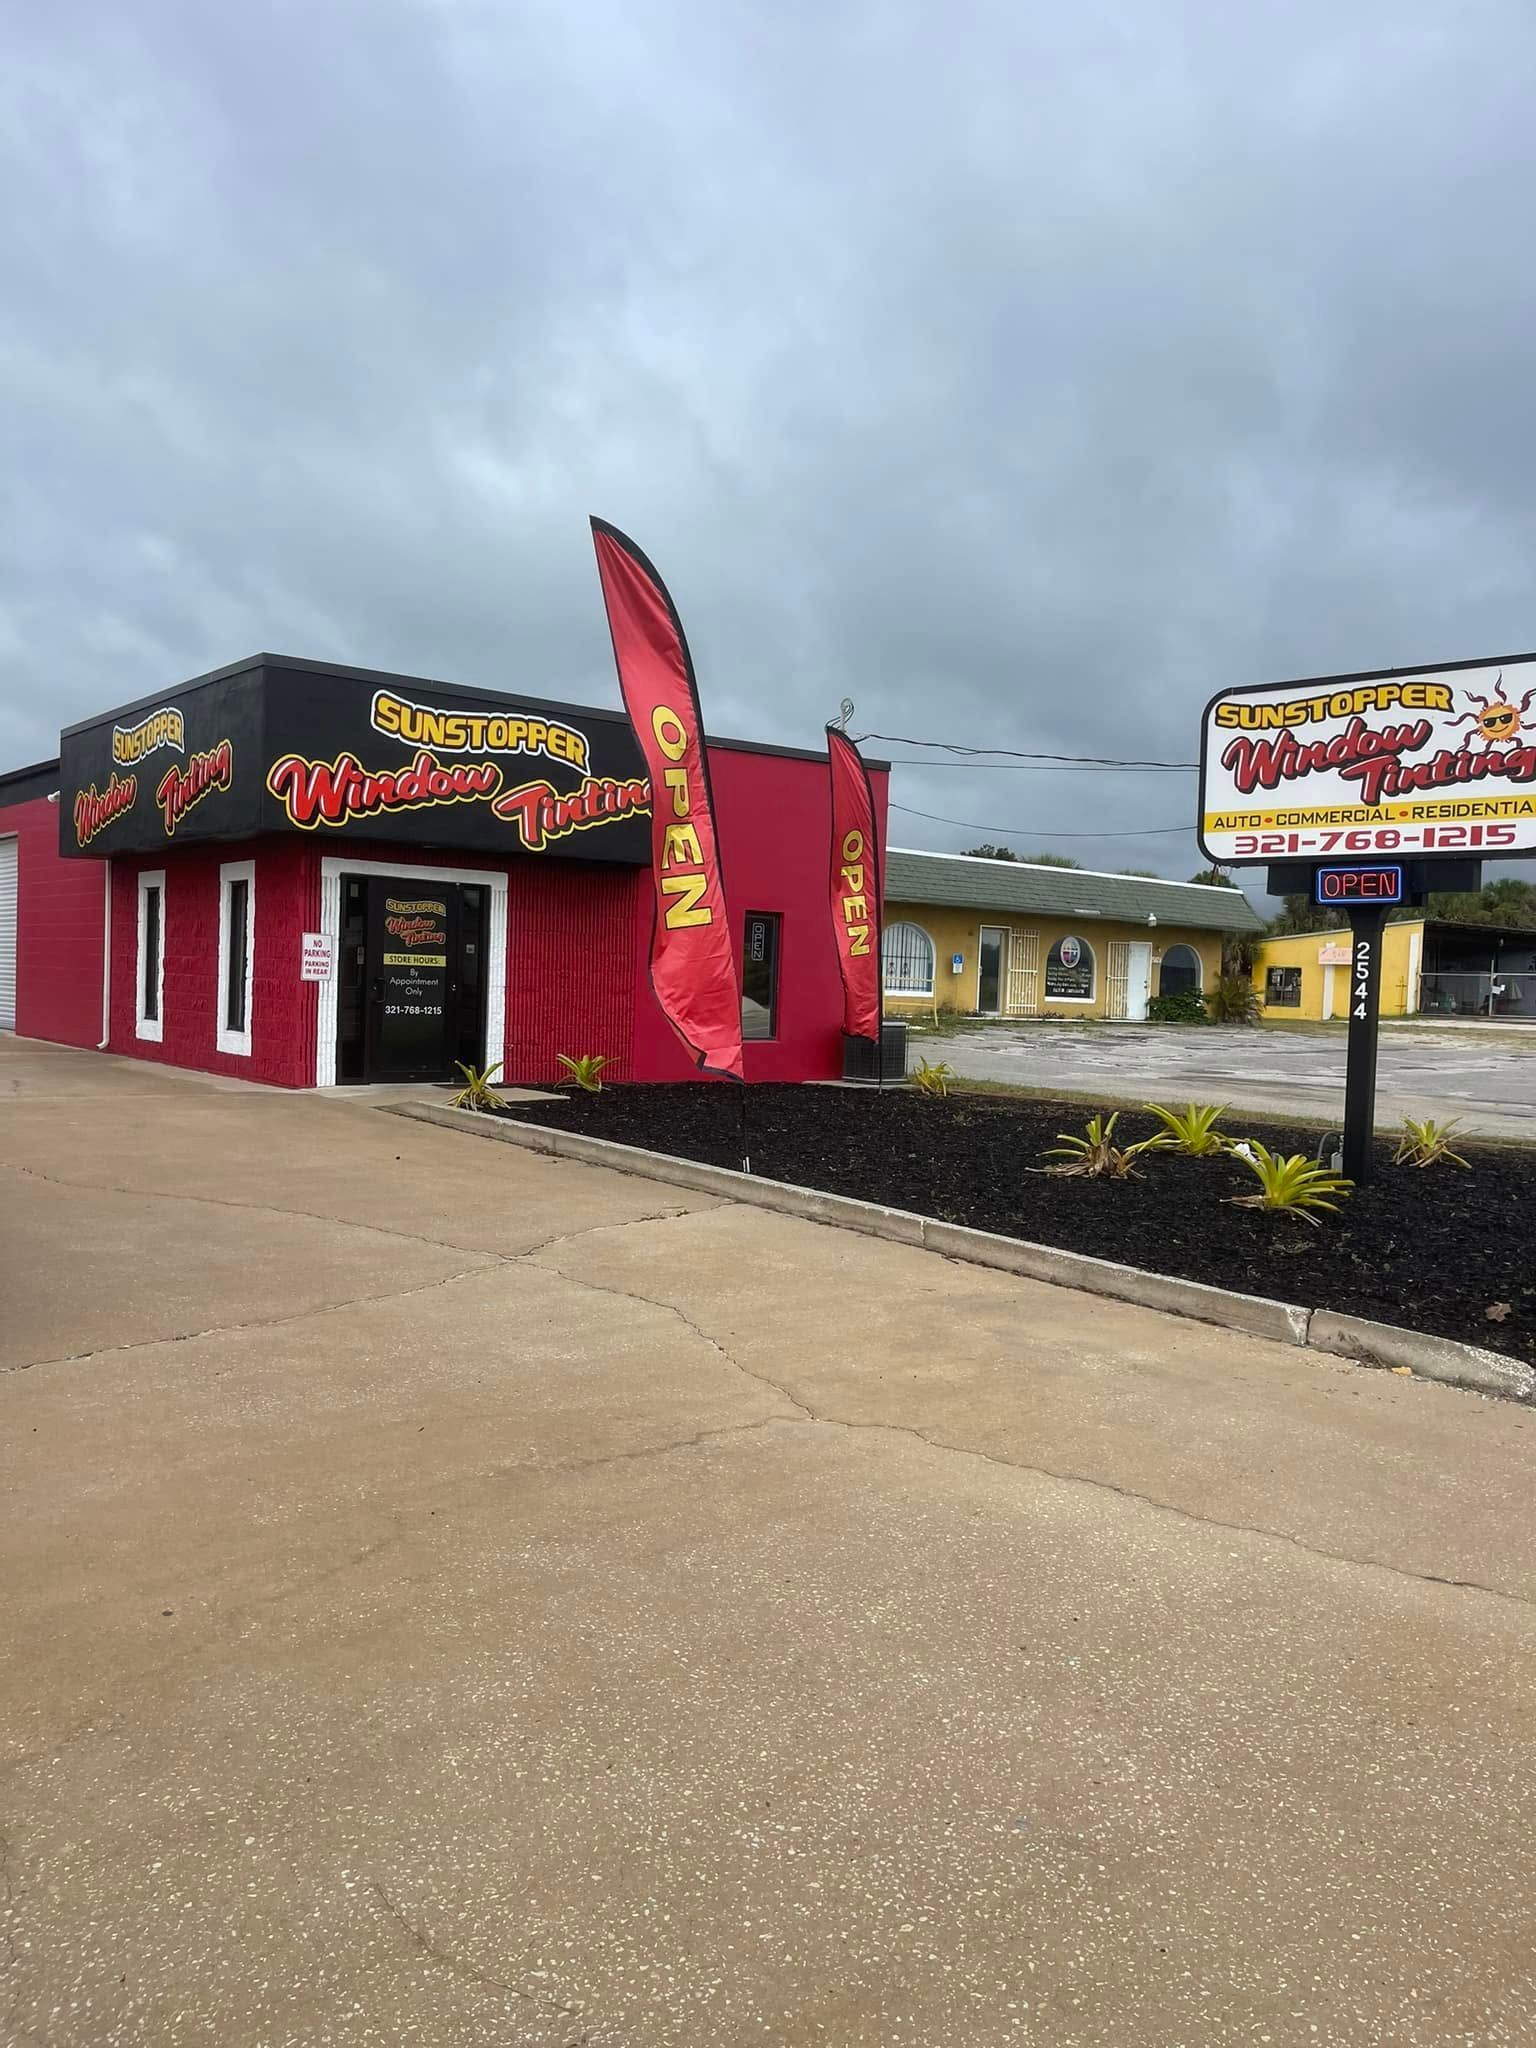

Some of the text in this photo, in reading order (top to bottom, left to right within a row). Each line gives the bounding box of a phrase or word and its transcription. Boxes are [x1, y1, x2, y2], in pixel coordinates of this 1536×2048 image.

[1215, 683, 1454, 729] SUNSTOPPER
[113, 708, 184, 765] SUNSTOPPER
[371, 690, 590, 775] SUNSTOPPER
[1221, 717, 1433, 793] Window
[1341, 747, 1536, 806] Tinting
[74, 739, 233, 847] Window Tinting
[268, 752, 652, 851] Window Tintin
[652, 704, 713, 931] OPEN
[1214, 800, 1536, 829] AUTO COMMERCIAL RESIDENTIA
[1234, 824, 1517, 855] 321-768-1215
[840, 829, 871, 957] OPEN
[1322, 872, 1397, 897] OPEN
[386, 898, 447, 917] SUNSTOPPER
[385, 917, 436, 935] Window
[400, 930, 446, 947] Tinting
[304, 949, 331, 958] PARKING
[313, 940, 323, 948] NO
[754, 925, 763, 958] OPEN
[304, 960, 329, 968] PARKING
[389, 955, 412, 963] STORE
[410, 968, 419, 977] By
[389, 977, 439, 986] Appointment
[405, 986, 423, 996] Only
[1353, 941, 1371, 1020] 2544
[385, 1005, 442, 1015] 321-768-1215
